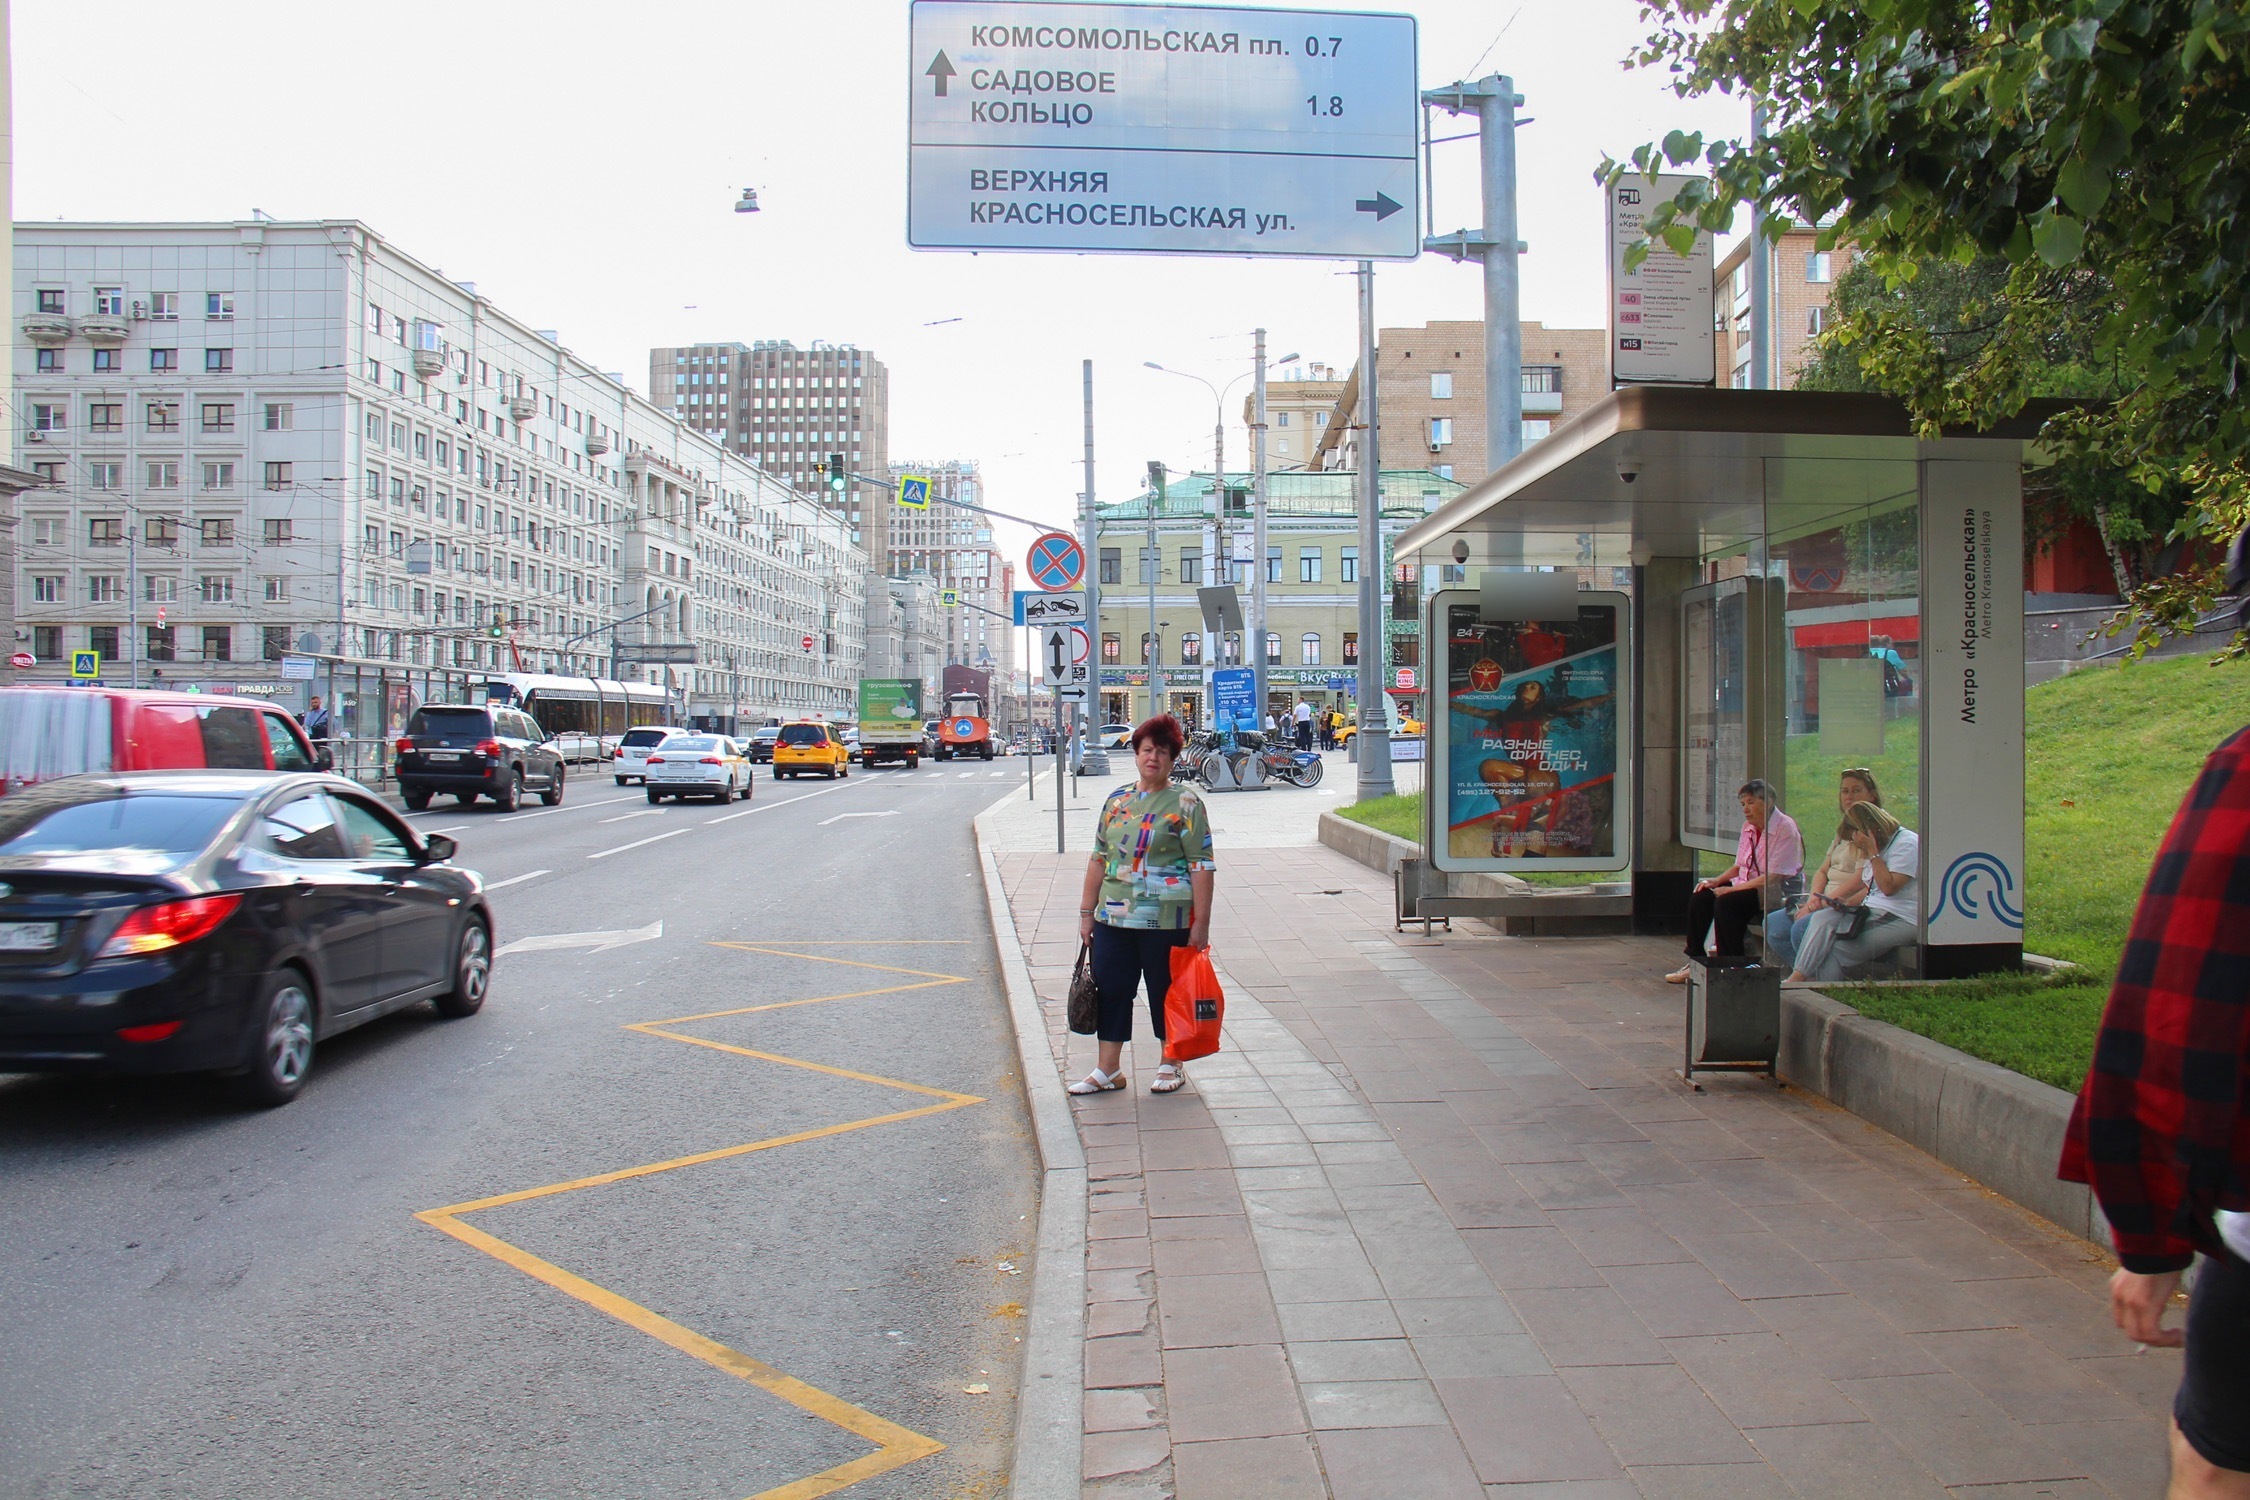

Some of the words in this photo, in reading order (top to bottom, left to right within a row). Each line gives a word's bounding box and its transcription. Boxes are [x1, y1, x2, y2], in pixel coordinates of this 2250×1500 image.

[971, 25, 1240, 54] КОМСОМОЛЬСКАЯ
[1249, 37, 1291, 56] пл.
[1304, 36, 1344, 58] 0.7
[970, 69, 1116, 95] САДОВОЕ
[970, 101, 1094, 128] КОЛЬЦО
[1306, 96, 1344, 117] 1.8
[970, 169, 1109, 193] ВЕРХНЯЯ
[970, 202, 1247, 230] КРАСНОСЕЛЬСКАЯ
[1255, 213, 1296, 235] ул.
[1625, 295, 1637, 303] 40
[1623, 340, 1638, 348] н15
[1980, 511, 1993, 600] Krasnoselskaya
[1961, 508, 1979, 660] «Красносельская»
[1980, 602, 1991, 639] Metro
[237, 685, 275, 695] ПРАВДА
[1961, 668, 1978, 725] Метро
[1482, 739, 1553, 750] РАЗНЫЕ
[1510, 750, 1581, 761] ФИТНЕС
[1538, 761, 1588, 772] ОДИН
